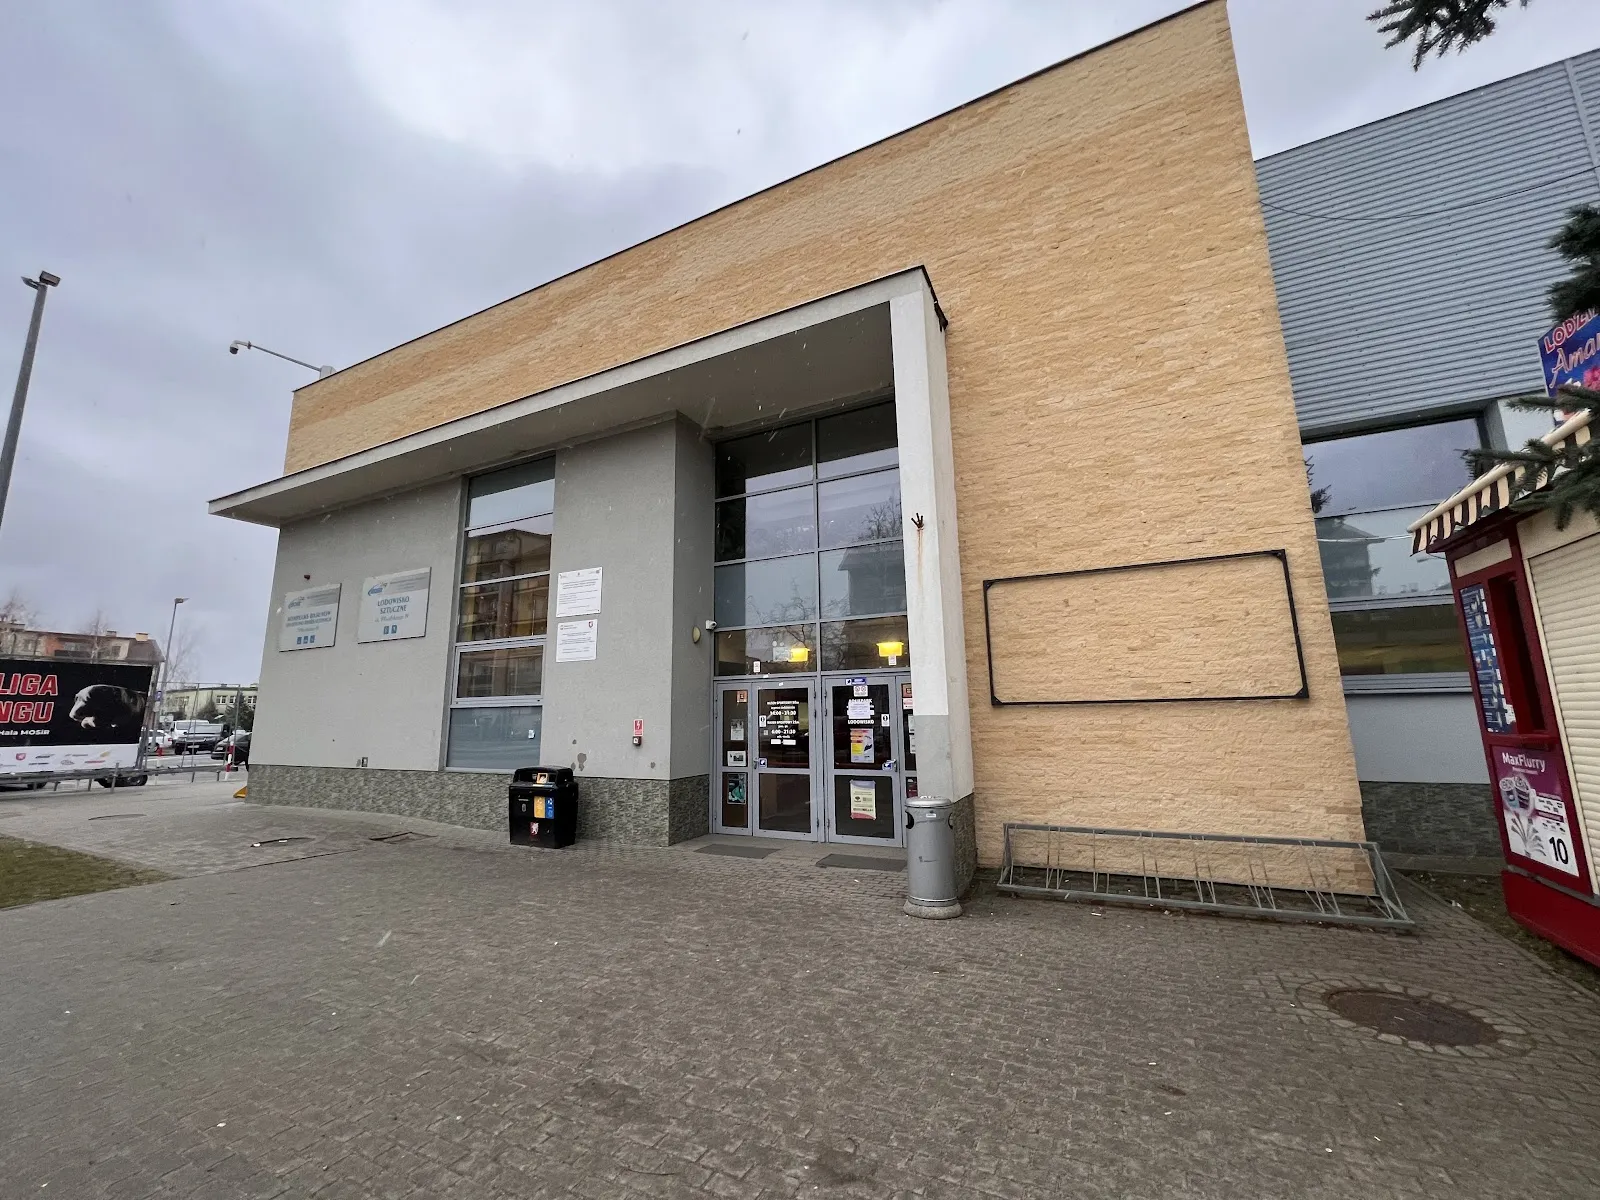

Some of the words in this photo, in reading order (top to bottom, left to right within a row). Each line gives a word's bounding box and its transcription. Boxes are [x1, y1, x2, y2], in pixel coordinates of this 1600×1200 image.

[377, 596, 410, 606] LODOWISKO
[380, 605, 407, 614] SZTUCZNE
[0, 673, 58, 696] LIGA
[1501, 752, 1546, 773] MaxFlurry
[1548, 836, 1569, 865] 10
